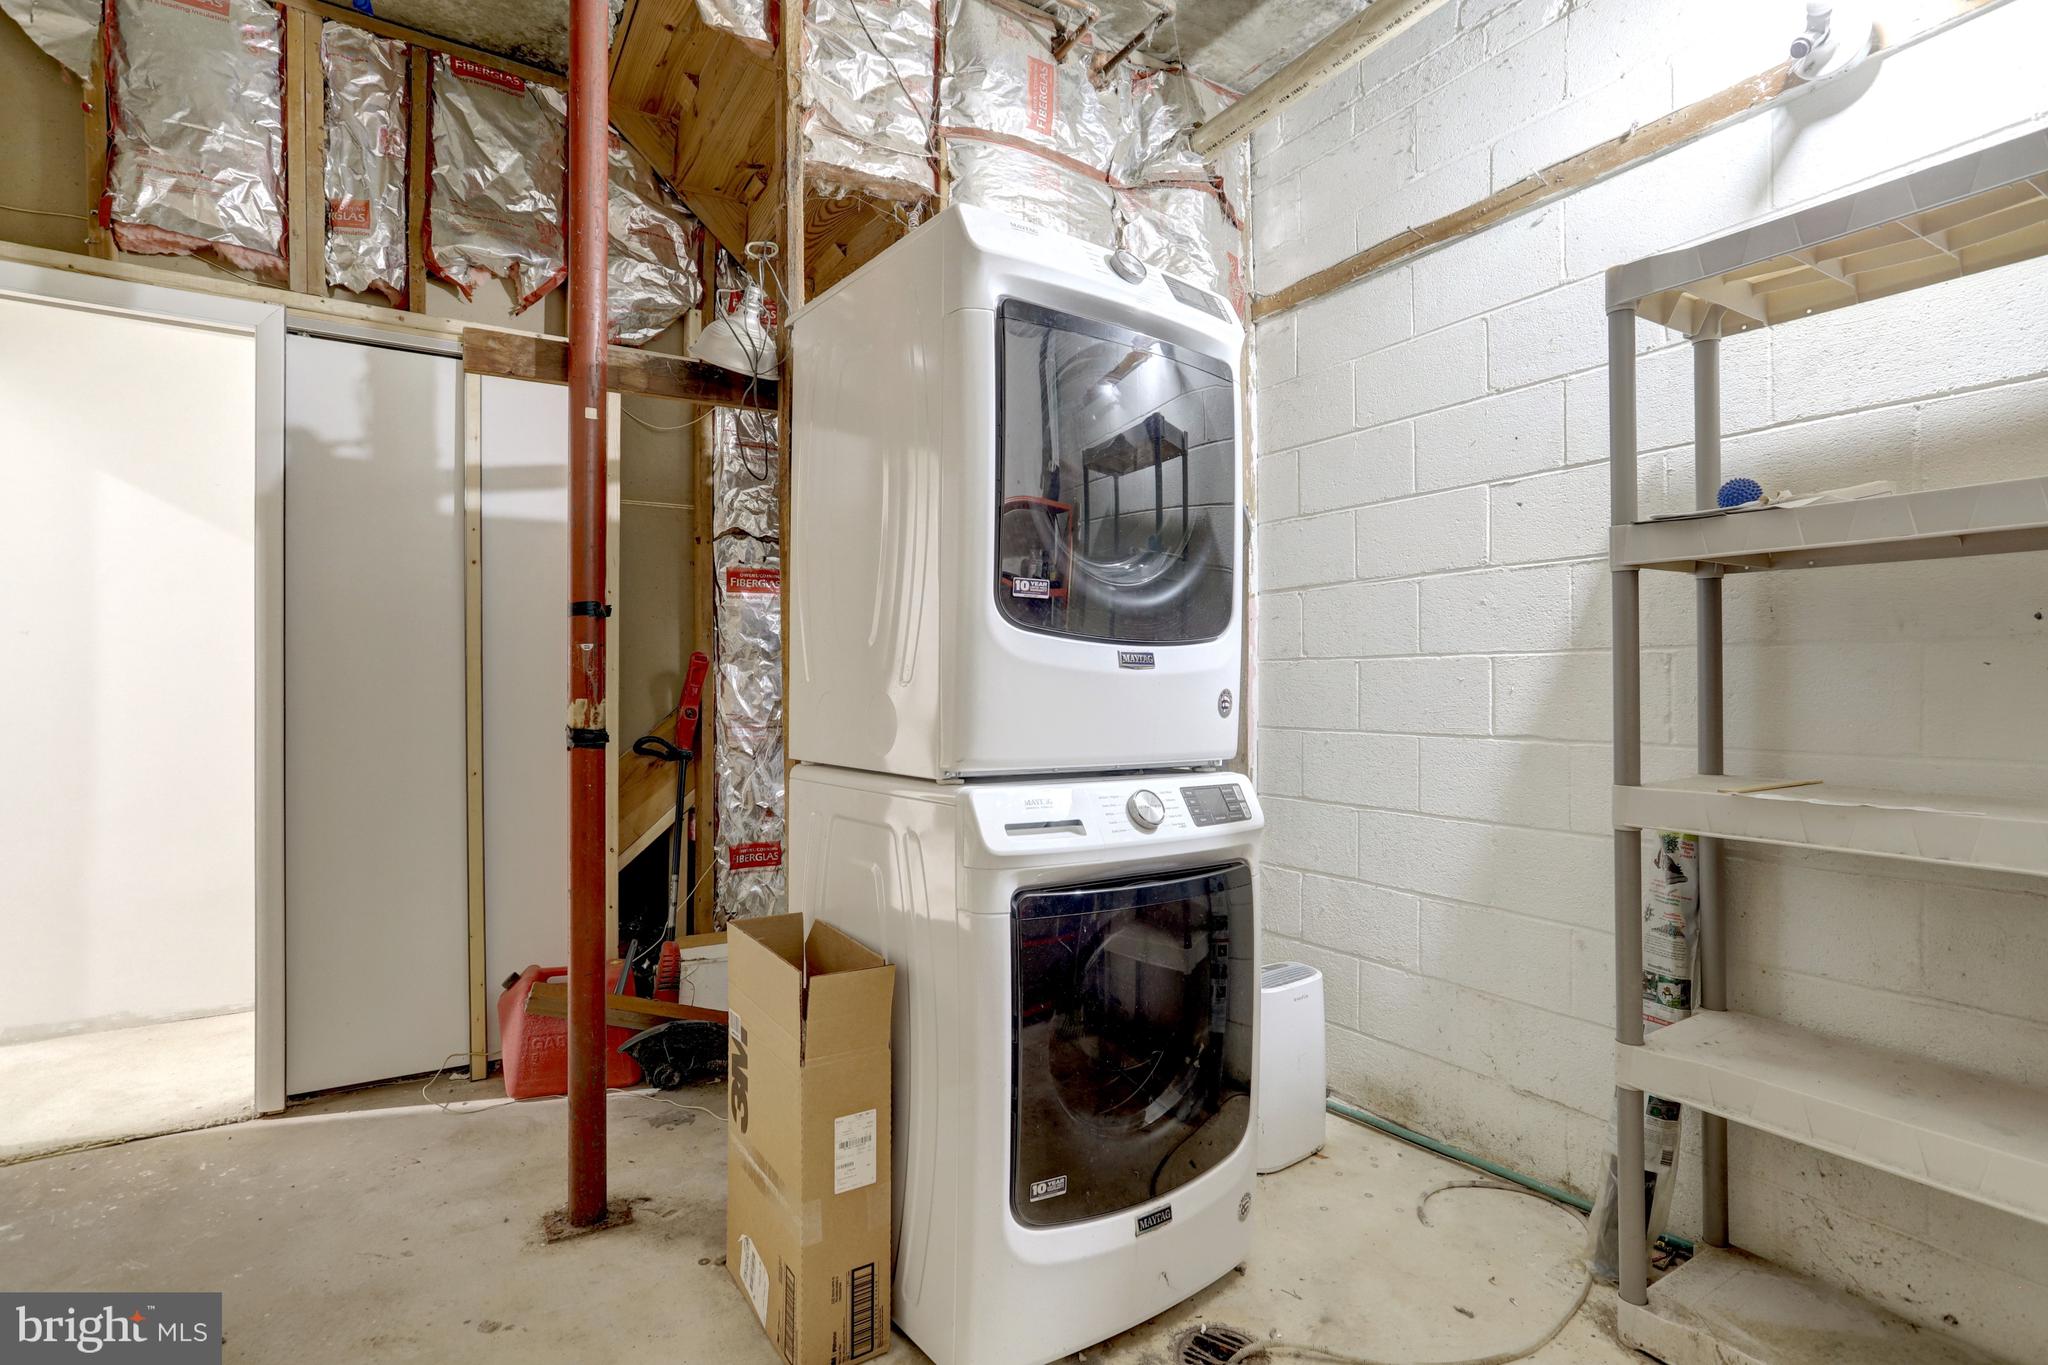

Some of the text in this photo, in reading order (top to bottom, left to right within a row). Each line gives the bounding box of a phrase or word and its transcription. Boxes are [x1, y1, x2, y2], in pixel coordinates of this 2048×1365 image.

[454, 59, 521, 85] FIBERGLAS
[1036, 65, 1049, 129] FIBERGLAS
[1015, 579, 1030, 591] 10
[1121, 653, 1154, 664] MAYTAG
[1032, 1182, 1047, 1196] 10
[1139, 1208, 1171, 1230] MAYTAG
